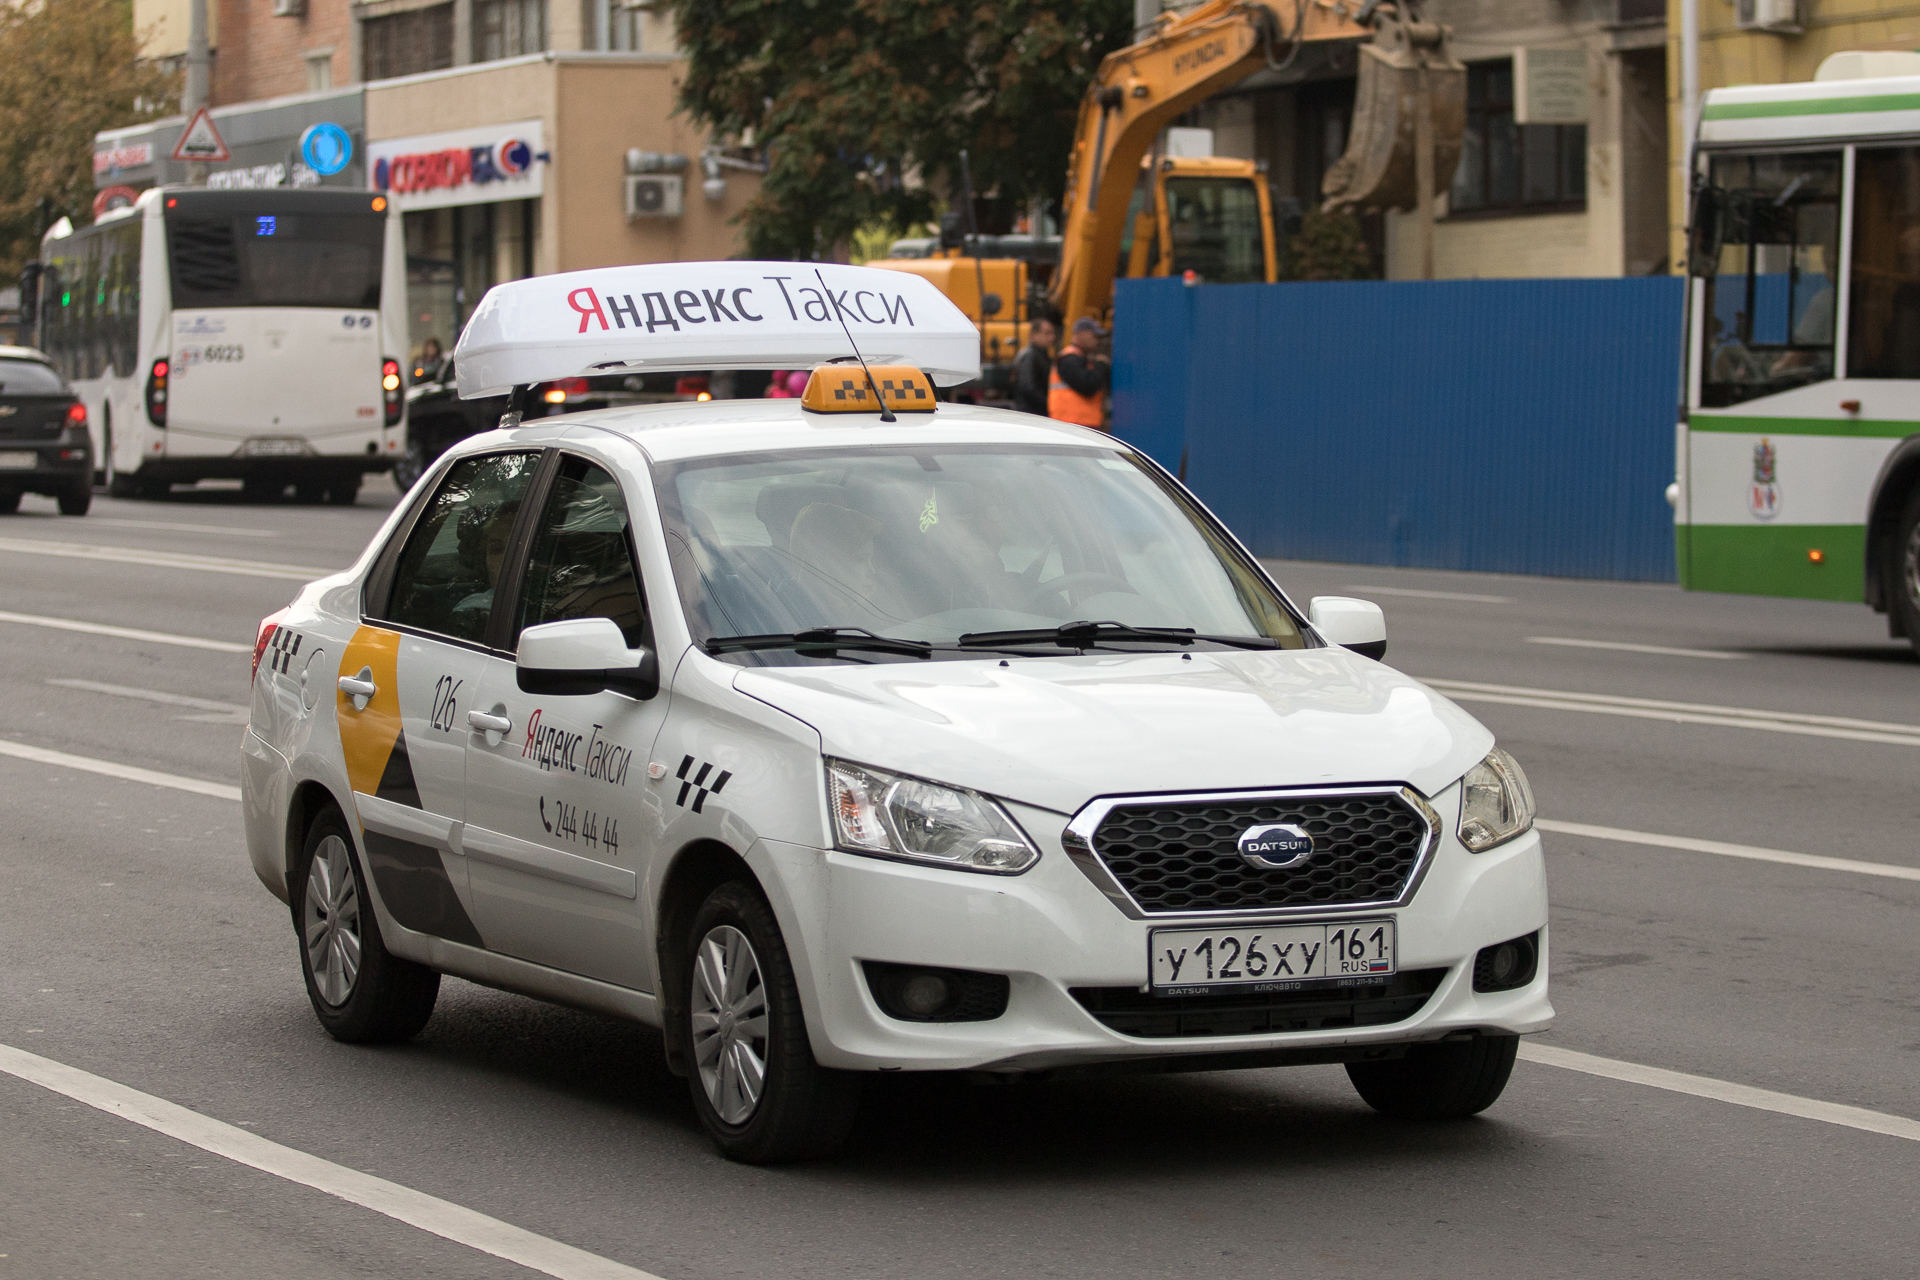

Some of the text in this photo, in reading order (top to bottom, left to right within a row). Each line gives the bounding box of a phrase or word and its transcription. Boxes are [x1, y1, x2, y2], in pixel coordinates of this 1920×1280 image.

[566, 276, 915, 334] Яндекс Такси
[430, 674, 464, 733] 126
[521, 708, 633, 787] Яндекс Такси
[554, 800, 619, 856] 244 44 44
[1247, 840, 1308, 852] DATSUN
[1328, 926, 1385, 961] 161
[1340, 960, 1369, 973] RUS
[1167, 987, 1209, 996] DATSUN
